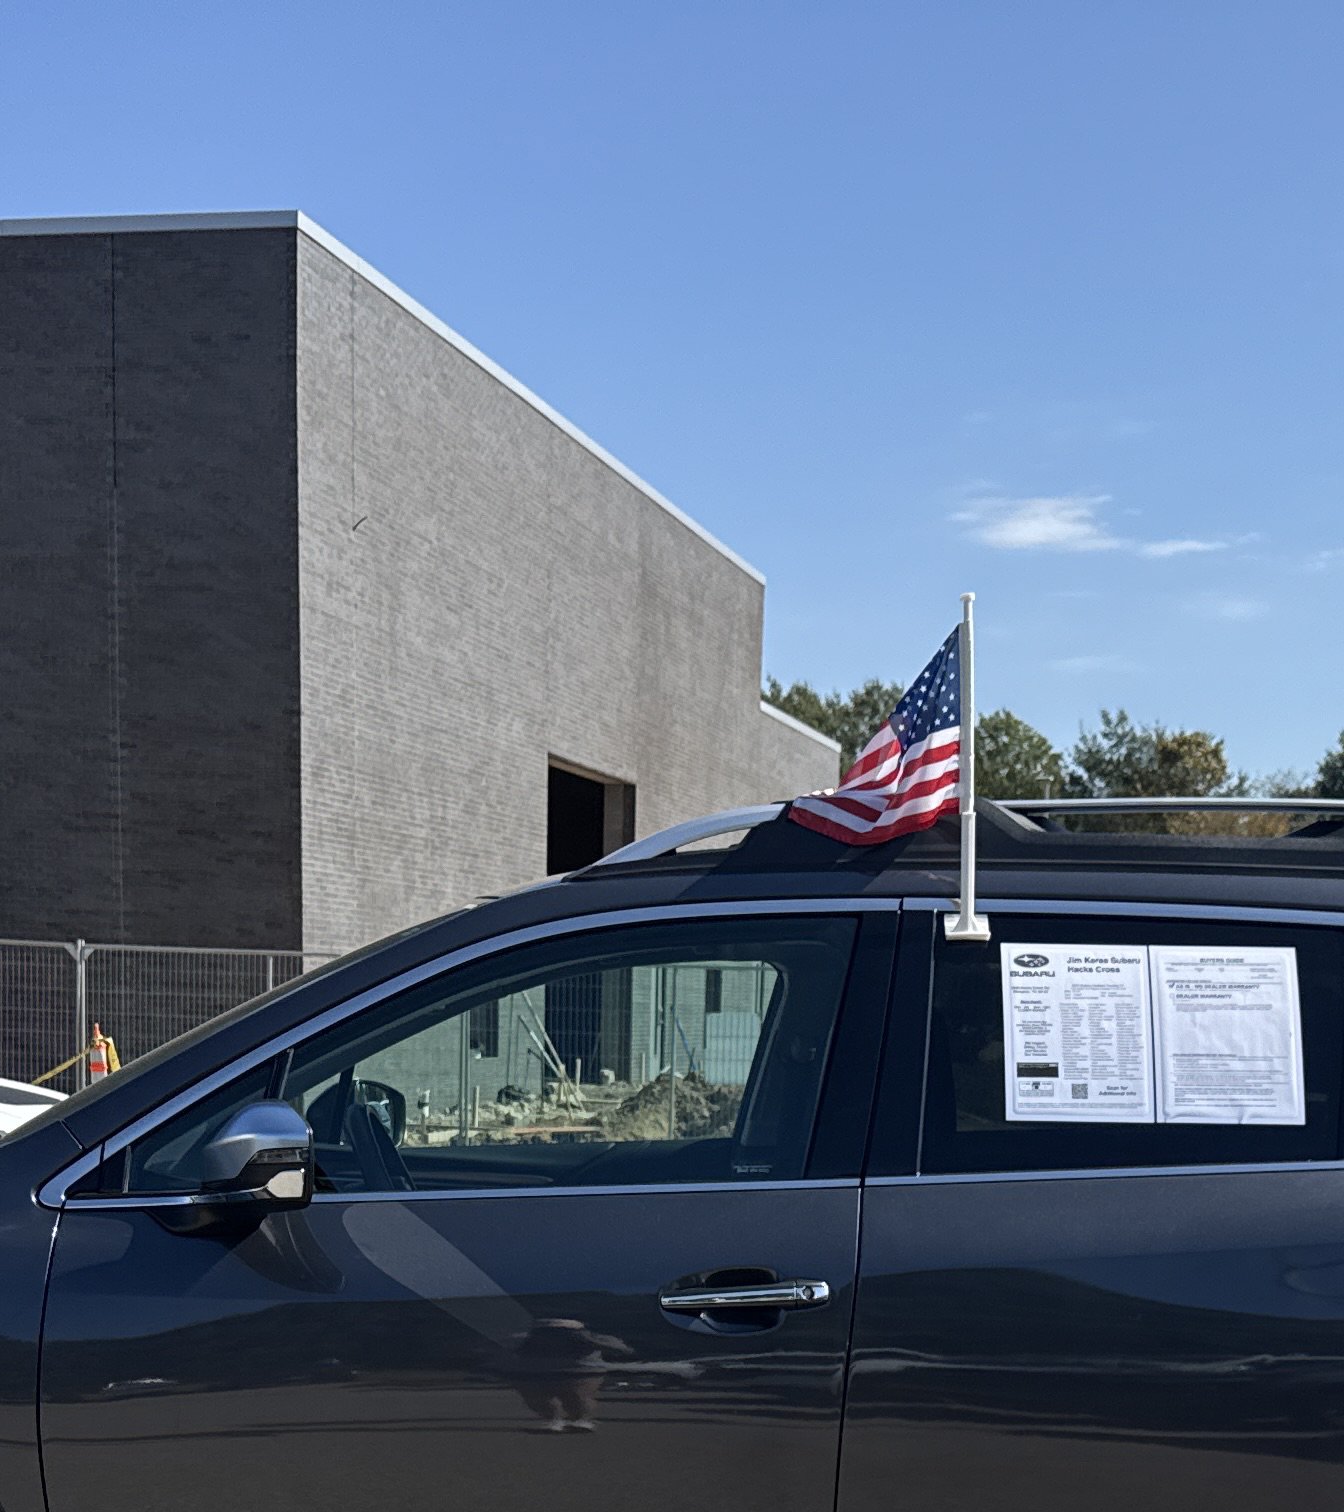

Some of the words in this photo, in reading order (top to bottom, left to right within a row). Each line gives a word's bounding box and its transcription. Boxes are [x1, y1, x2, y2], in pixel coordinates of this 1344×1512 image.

[1067, 956, 1083, 964] Jim
[1110, 956, 1141, 965] Subaru
[1010, 970, 1055, 978] SUBARU
